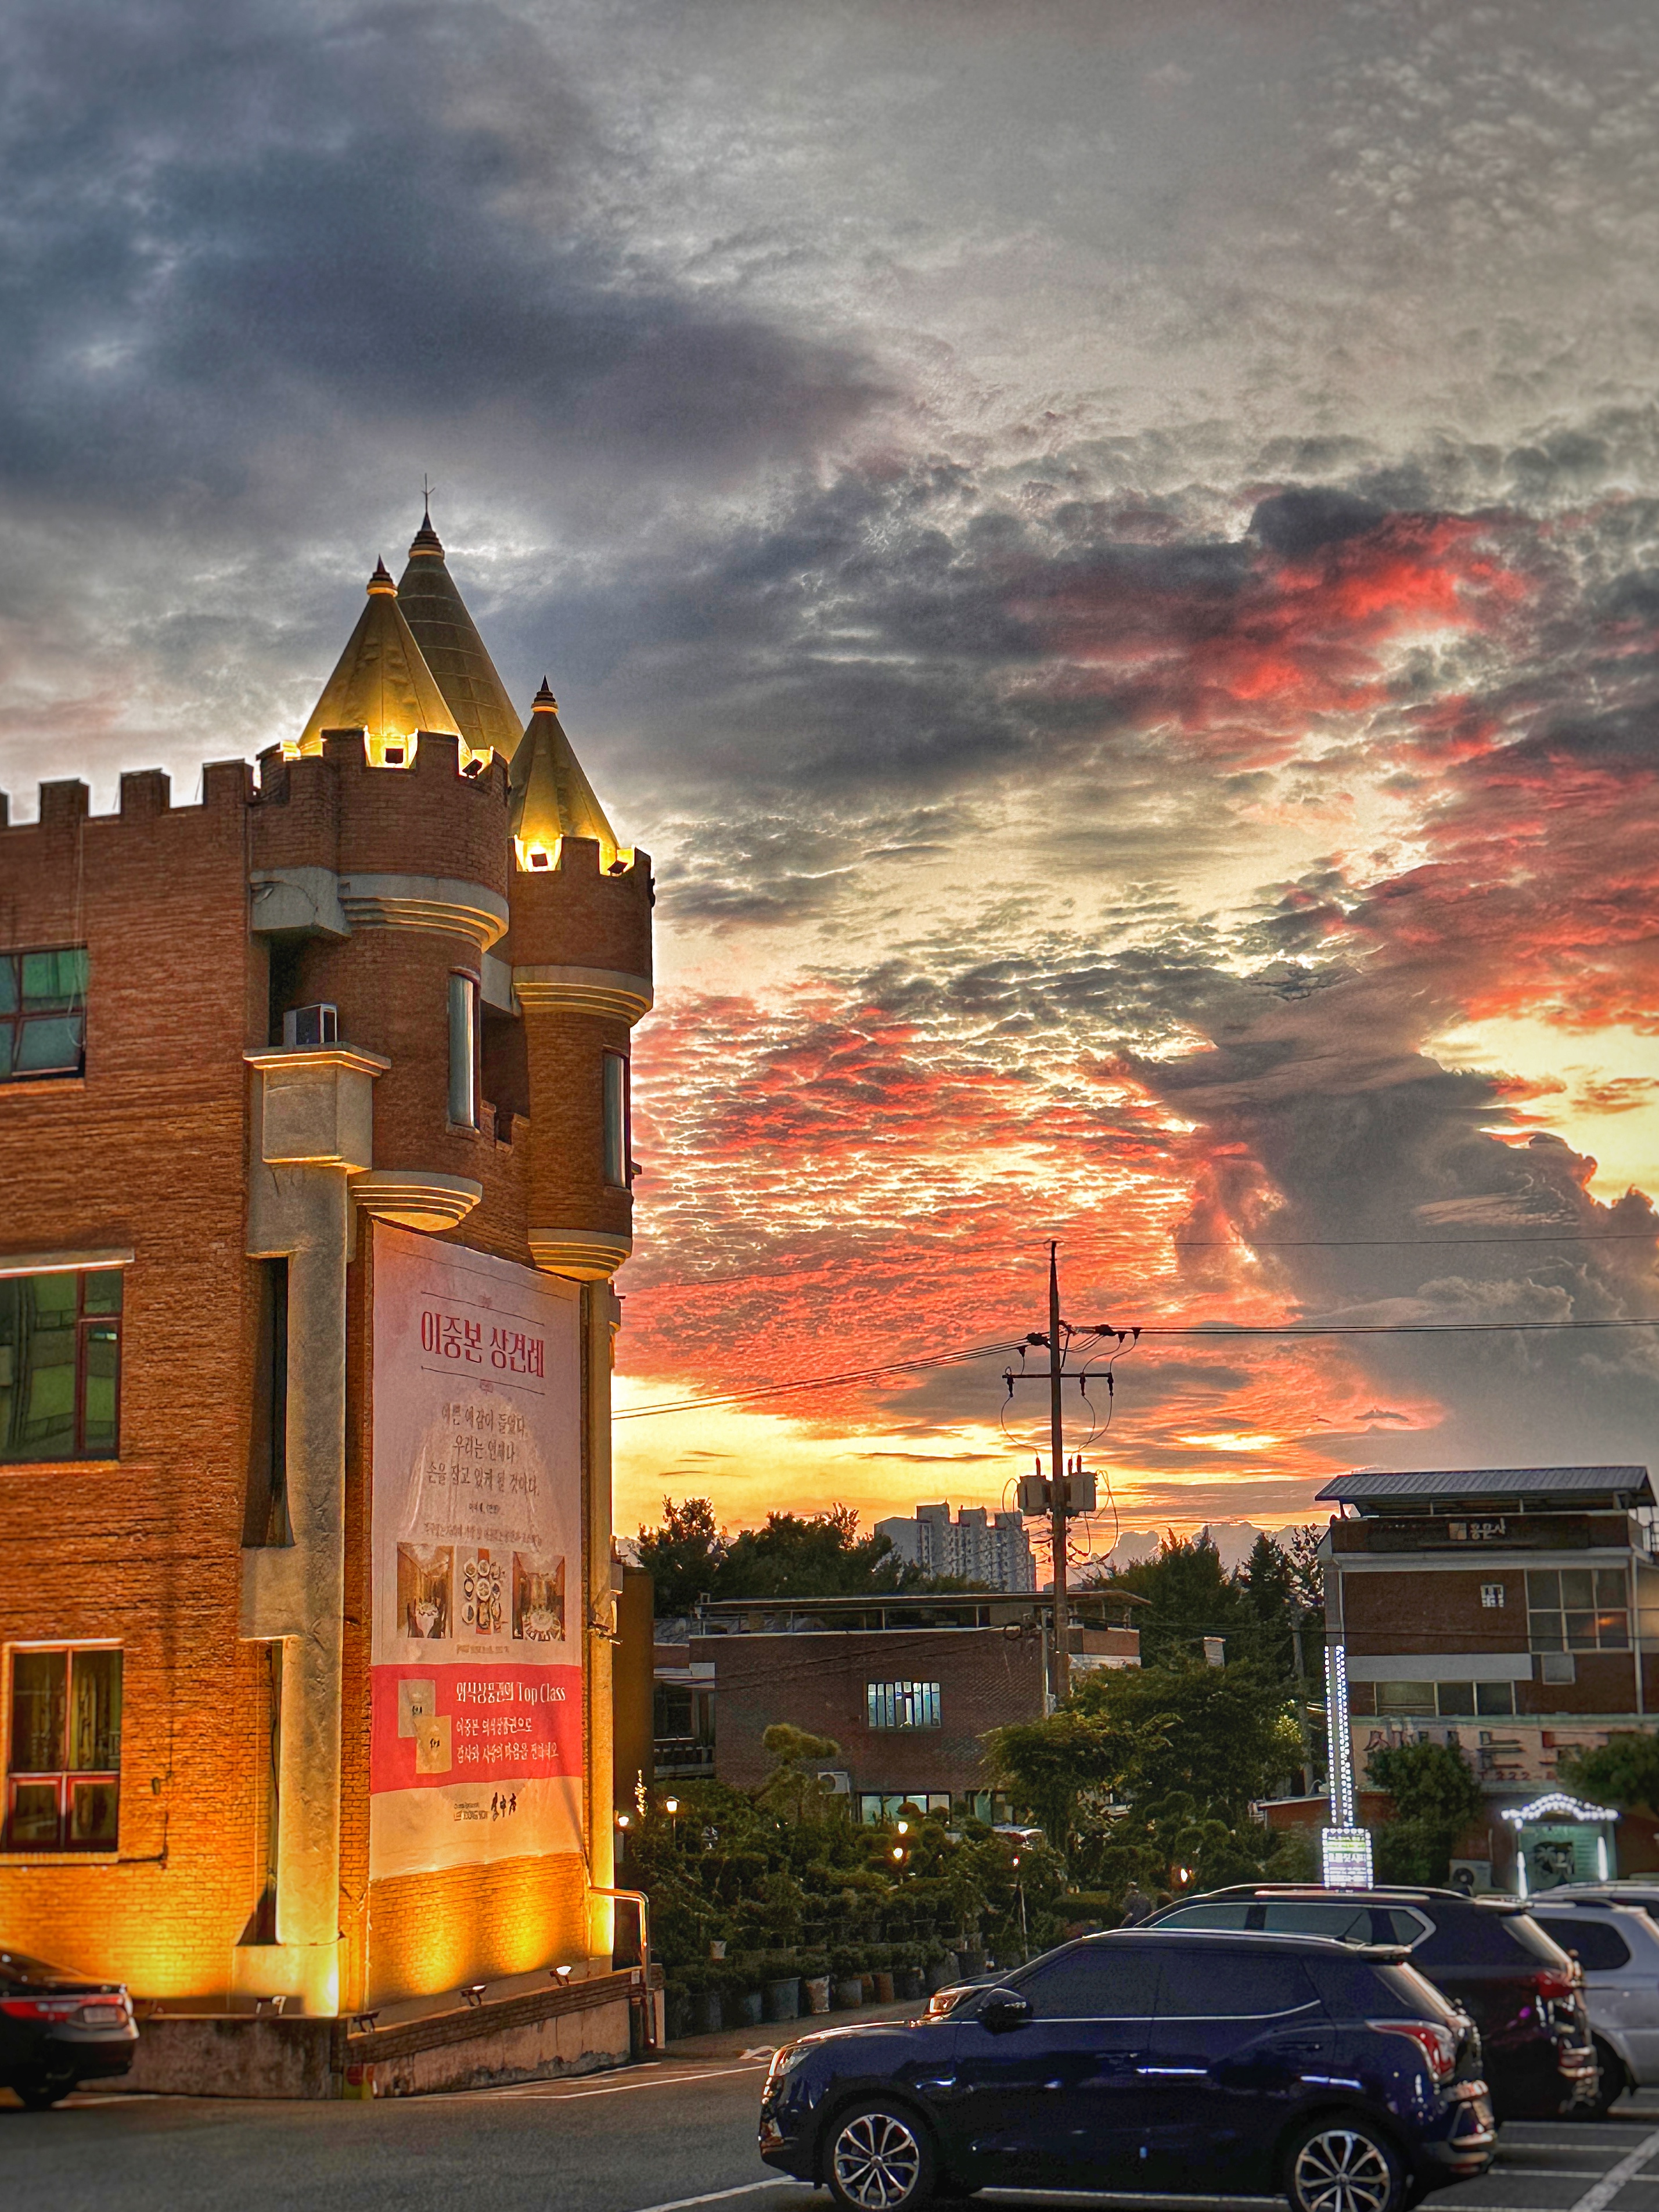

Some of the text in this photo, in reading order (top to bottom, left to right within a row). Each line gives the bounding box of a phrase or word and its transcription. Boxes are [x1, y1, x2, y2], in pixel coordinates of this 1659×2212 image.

[421, 1311, 544, 1378] 이중본 상견례
[452, 1434, 484, 1459] 우리는
[426, 1462, 447, 1486] 손을
[451, 1463, 470, 1486] 잡고
[516, 1682, 538, 1706] Top
[540, 1683, 566, 1703] Class
[505, 1742, 528, 1761] 마음을
